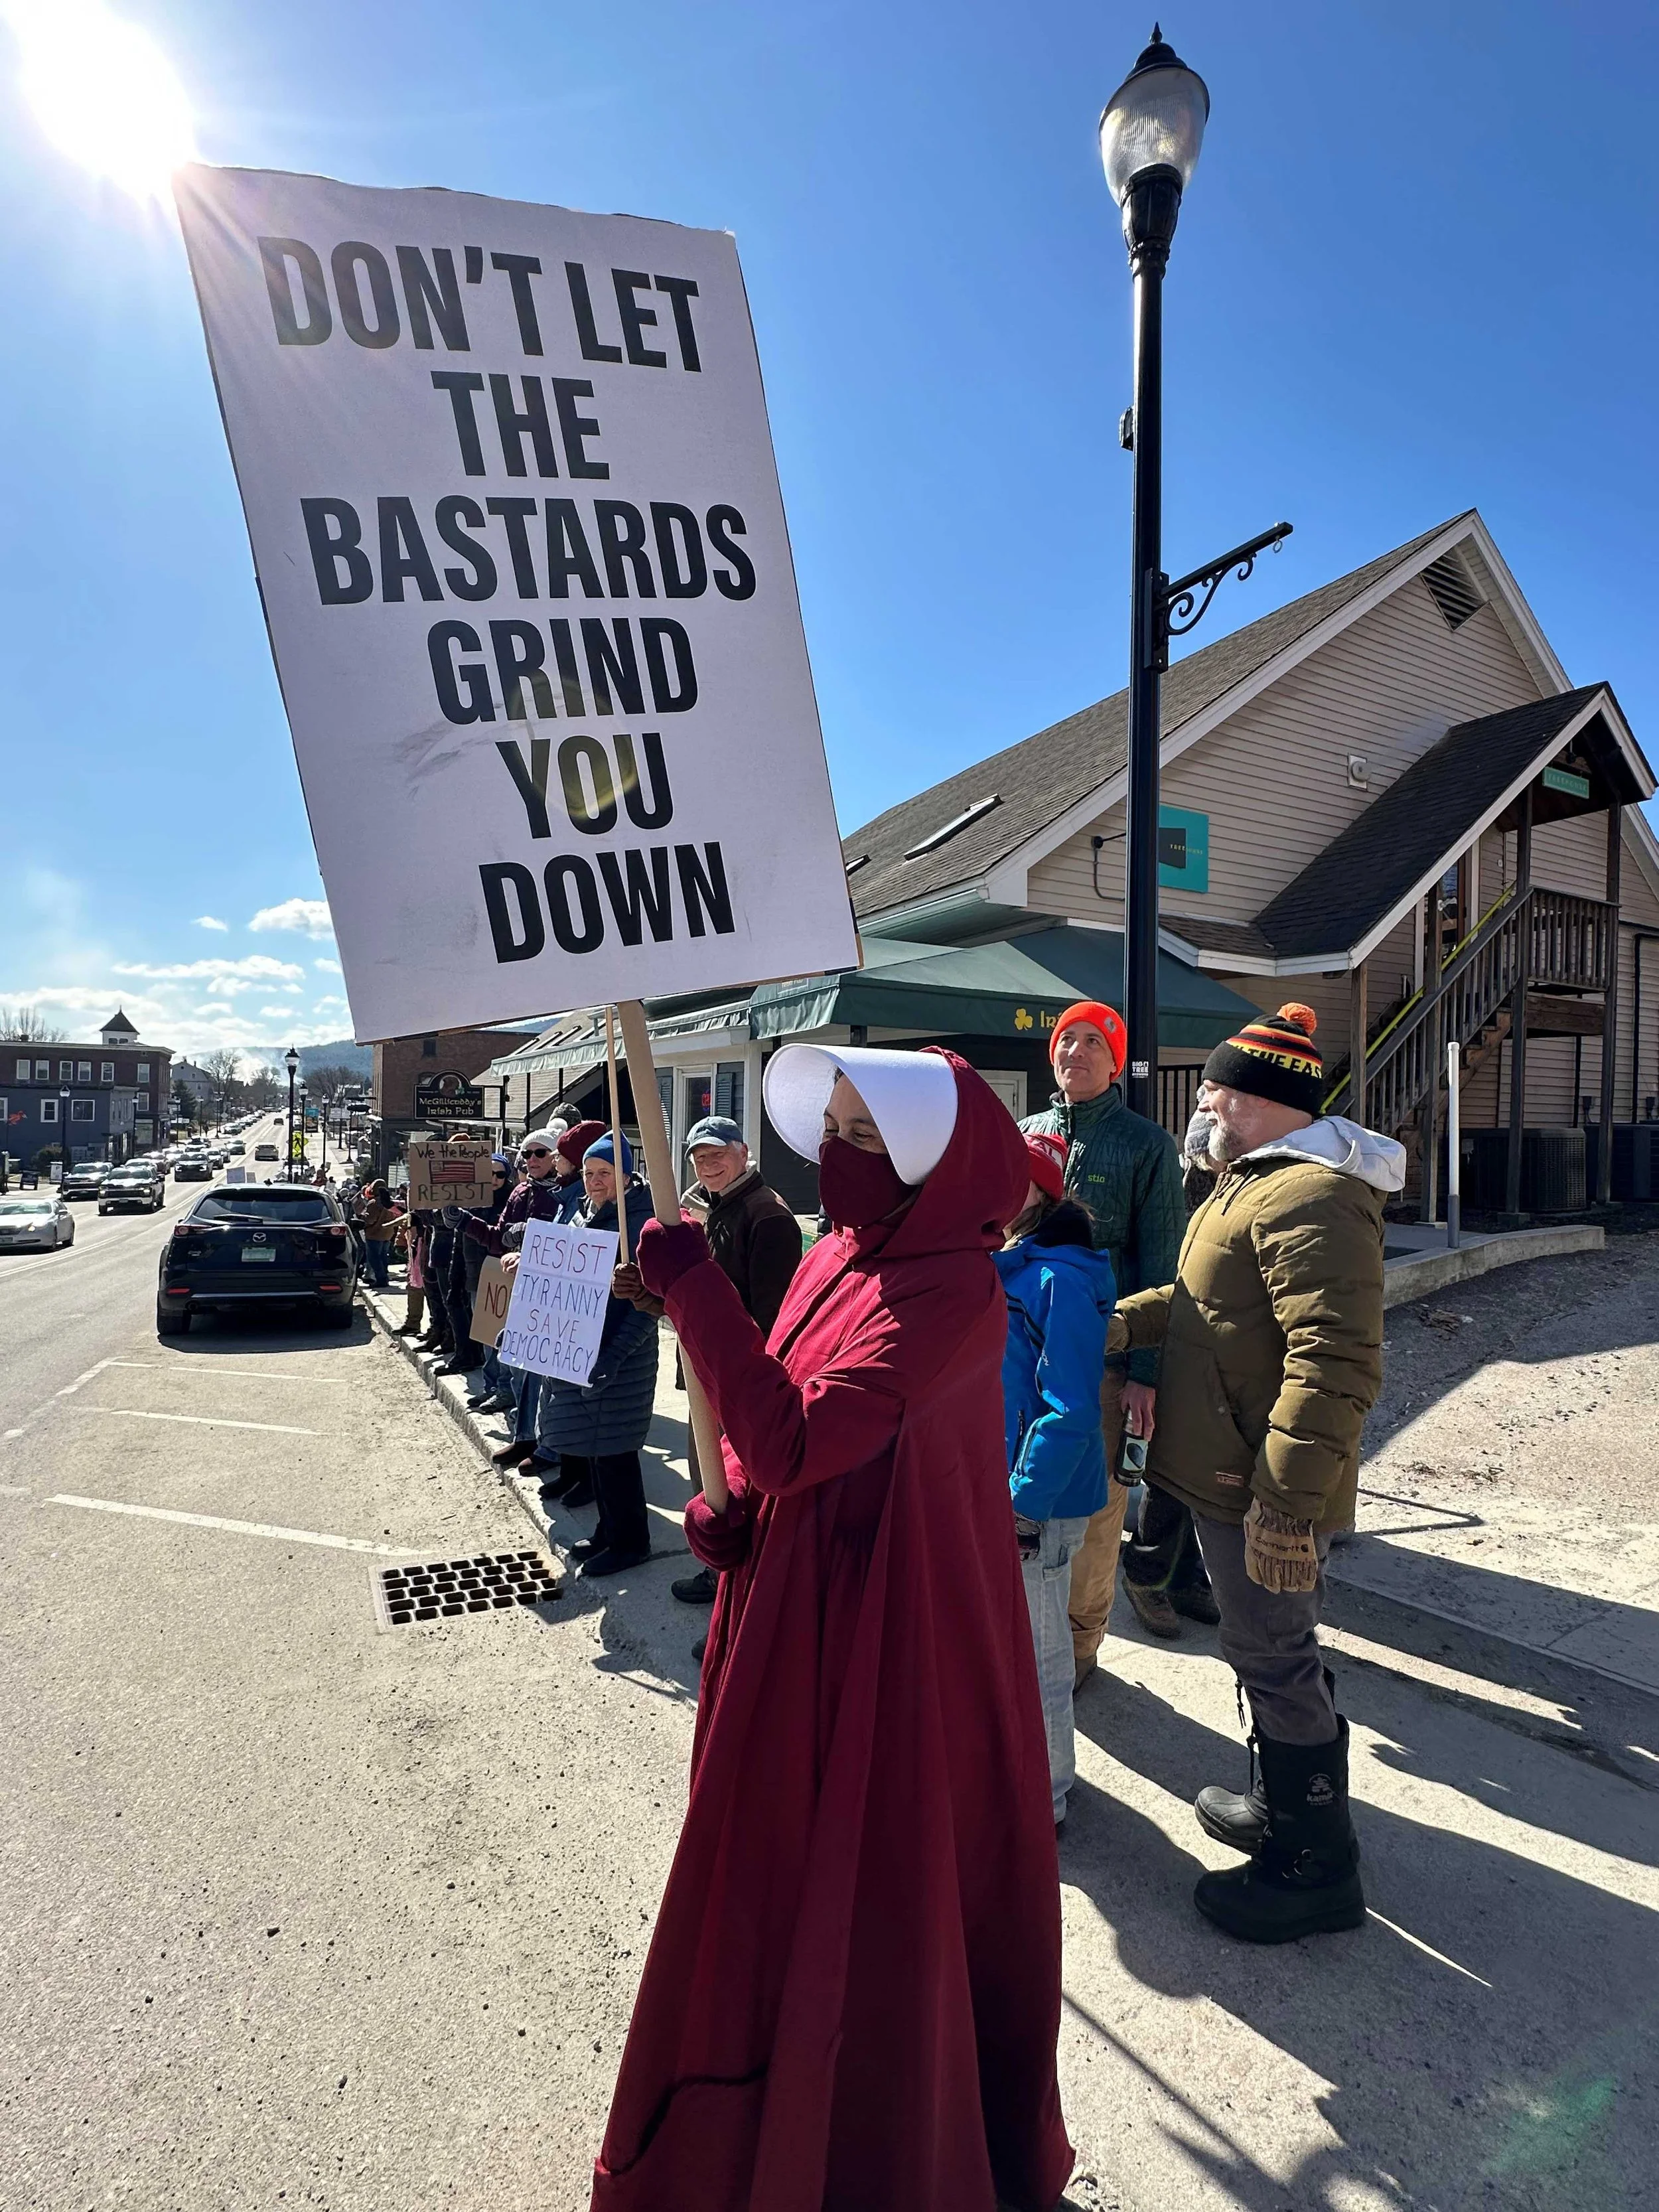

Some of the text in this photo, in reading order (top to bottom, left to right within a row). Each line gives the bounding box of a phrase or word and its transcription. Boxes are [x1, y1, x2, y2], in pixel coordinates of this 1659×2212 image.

[257, 236, 702, 372] DON'T LET
[431, 370, 610, 480] THE
[300, 495, 757, 605] BASTARDS
[427, 617, 698, 725] GRIND
[495, 732, 674, 839] YOU
[478, 841, 735, 964] DOWN
[414, 1143, 490, 1162] We the People
[418, 1182, 492, 1201] RESIST
[528, 1234, 608, 1274] RESIST
[484, 1282, 508, 1319] NO
[520, 1274, 604, 1319] TYRANNY
[527, 1309, 579, 1343] SAVE
[502, 1329, 594, 1374] DEMOCRACY
